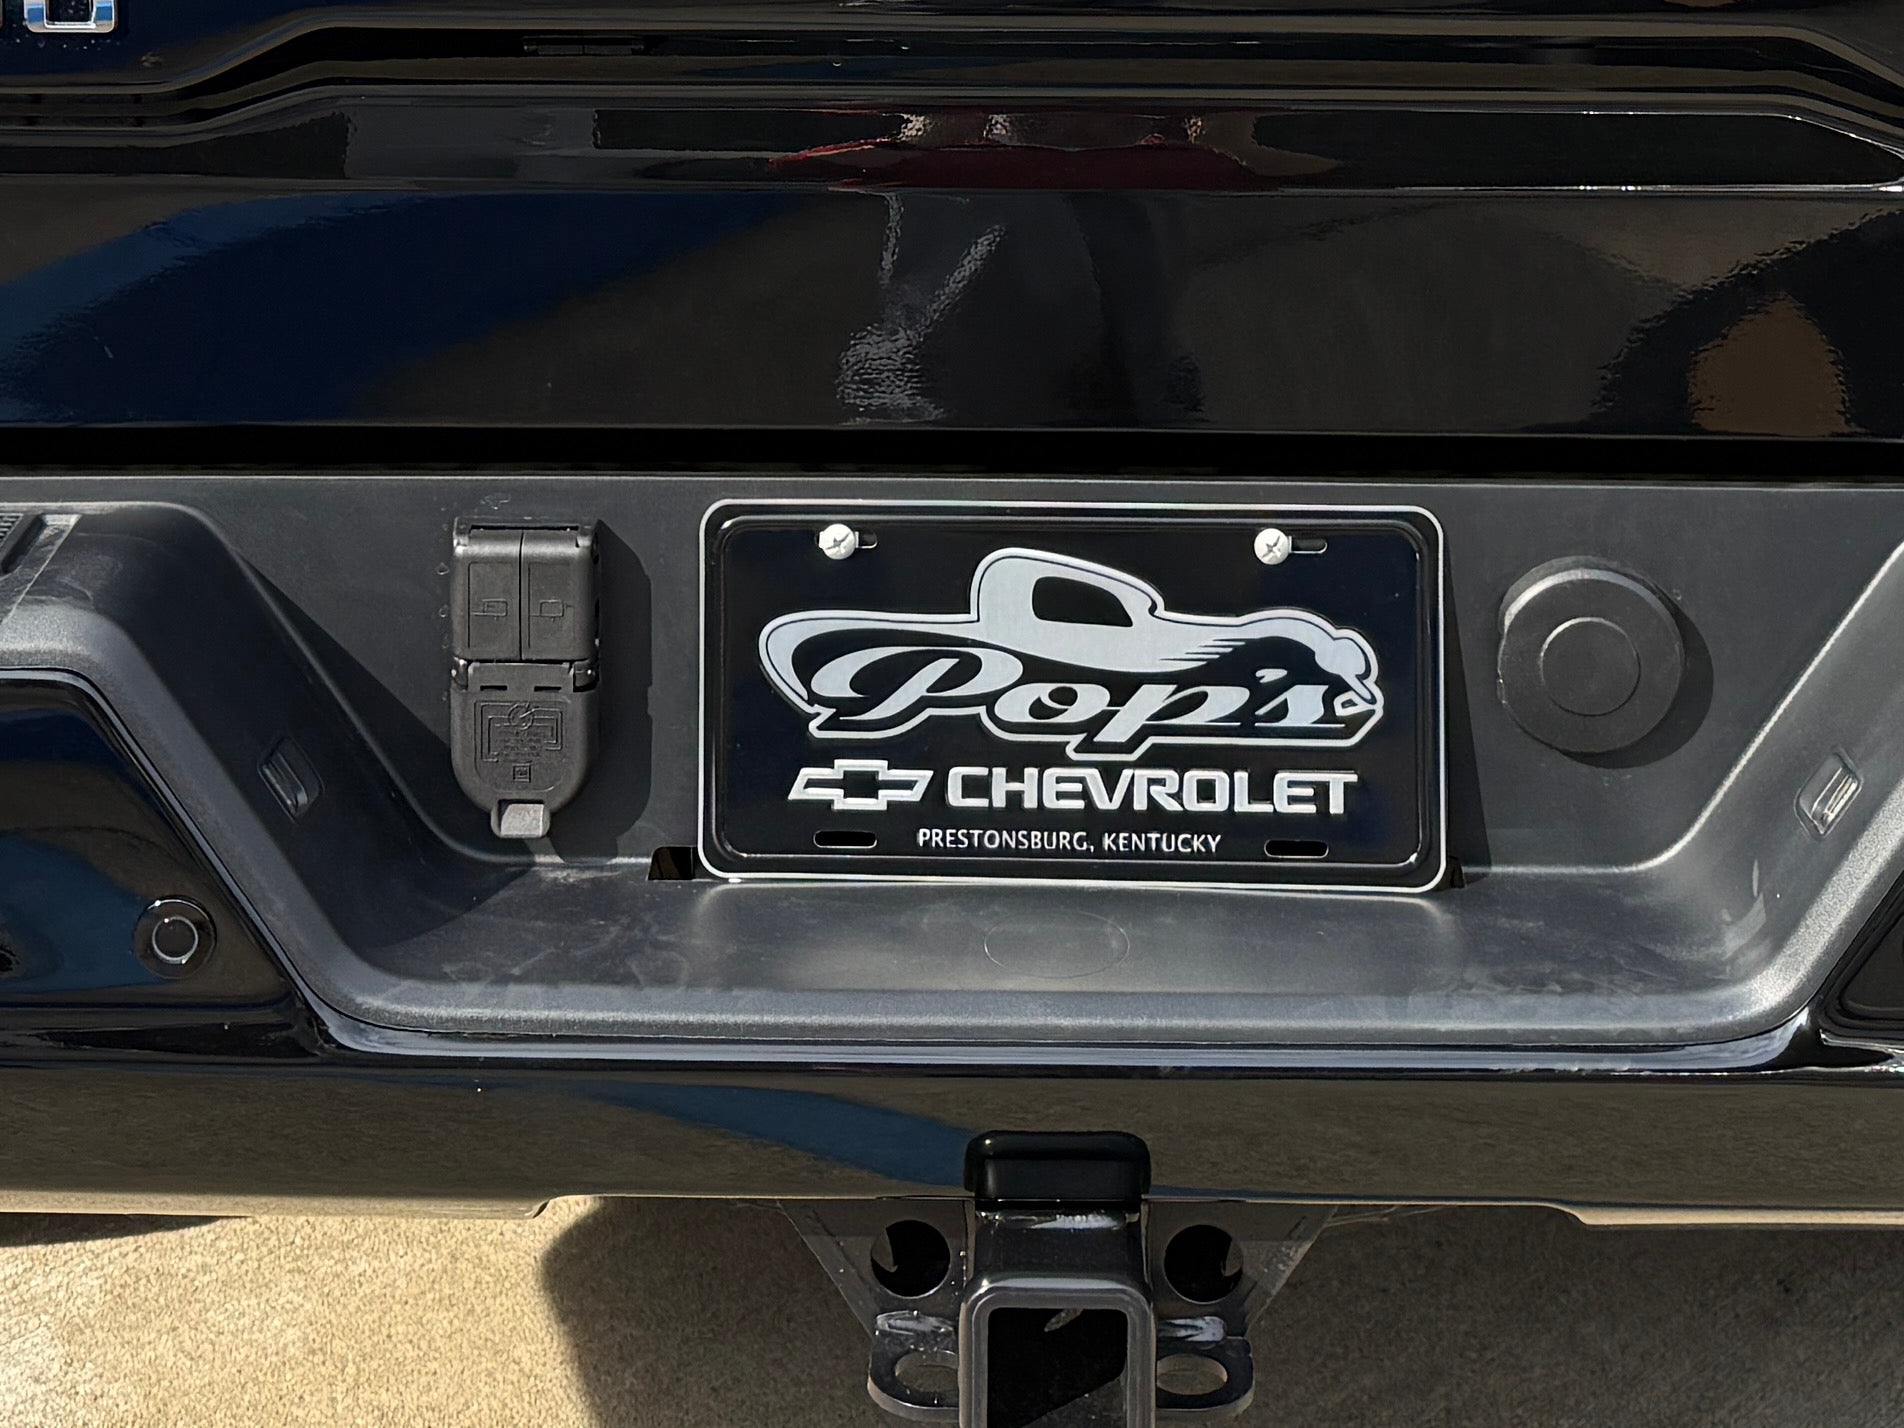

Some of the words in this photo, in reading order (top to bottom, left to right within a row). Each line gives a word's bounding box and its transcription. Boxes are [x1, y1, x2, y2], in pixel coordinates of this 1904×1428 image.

[810, 644, 1348, 744] Pop's
[946, 765, 1359, 815] CHEVROLET
[917, 827, 1096, 855] PRESTONSBURG,
[1102, 830, 1223, 855] KENTUCKY
